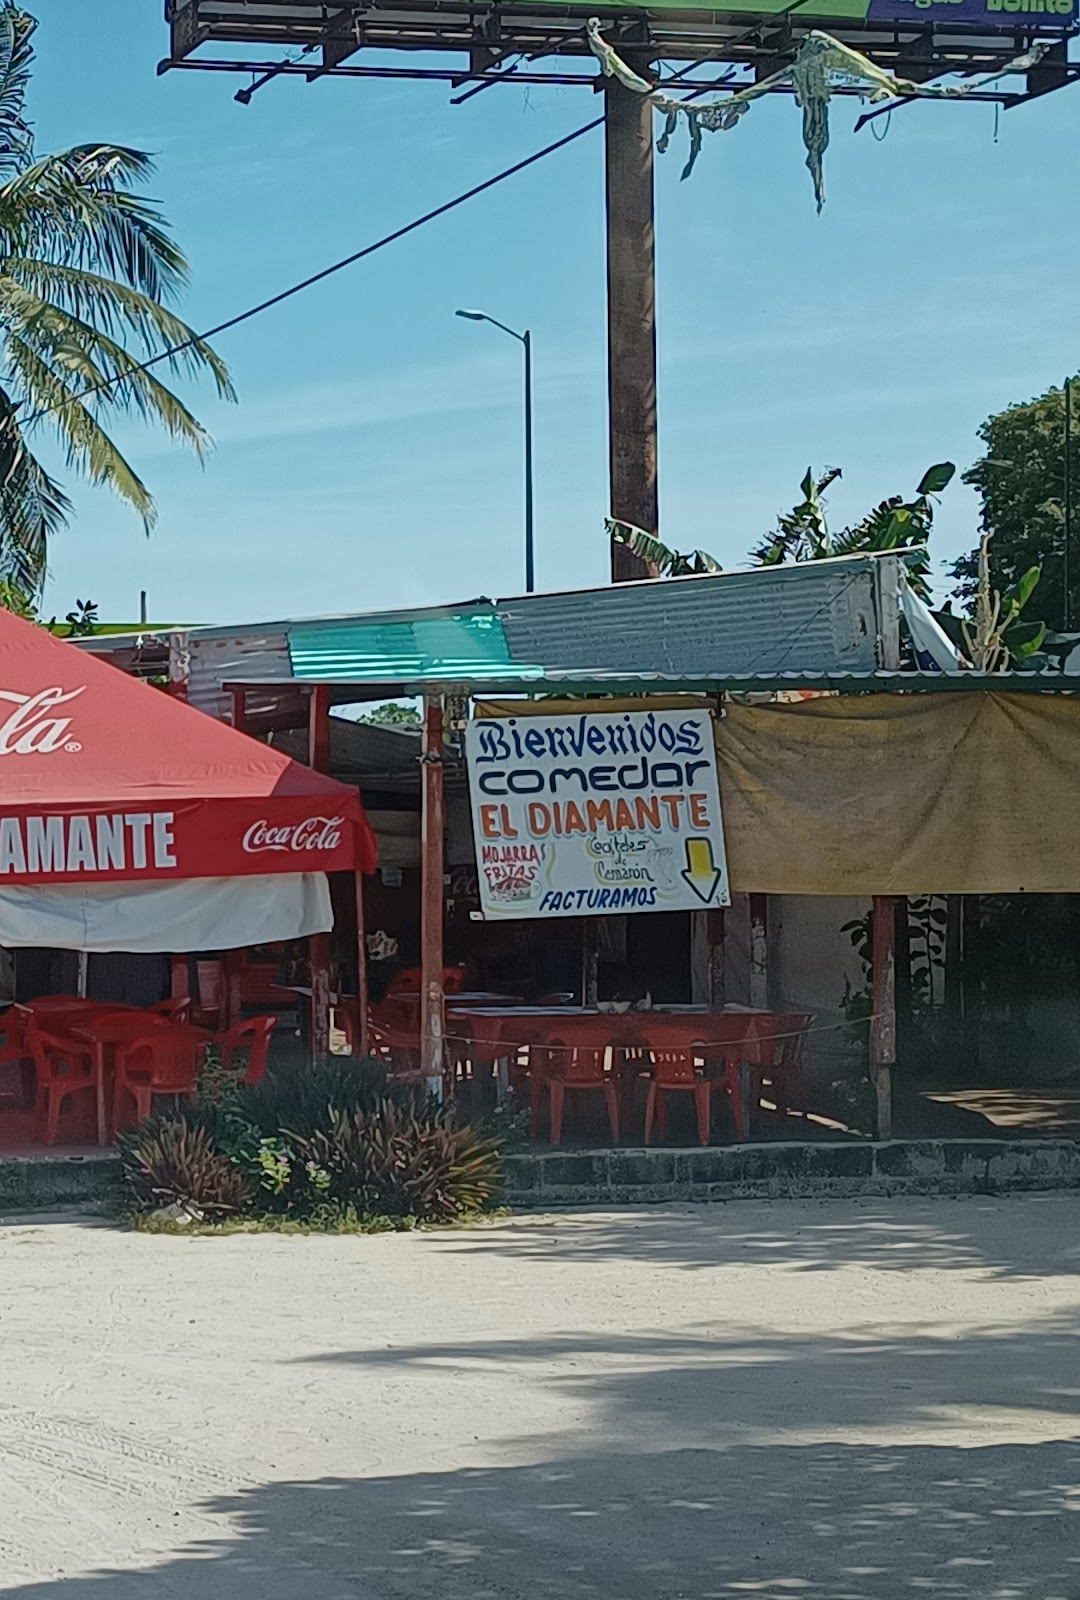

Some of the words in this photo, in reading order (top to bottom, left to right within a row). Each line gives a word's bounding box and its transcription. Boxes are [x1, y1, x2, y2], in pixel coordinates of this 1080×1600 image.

[475, 713, 705, 764] Bienvenidos
[479, 803, 519, 838] EL
[527, 793, 711, 836] DIAMANTE
[242, 815, 345, 853] Coca-Cola
[481, 843, 546, 866] MOJARRAS
[483, 864, 539, 884] FRITAS
[539, 886, 658, 911] FACTURAMOS
